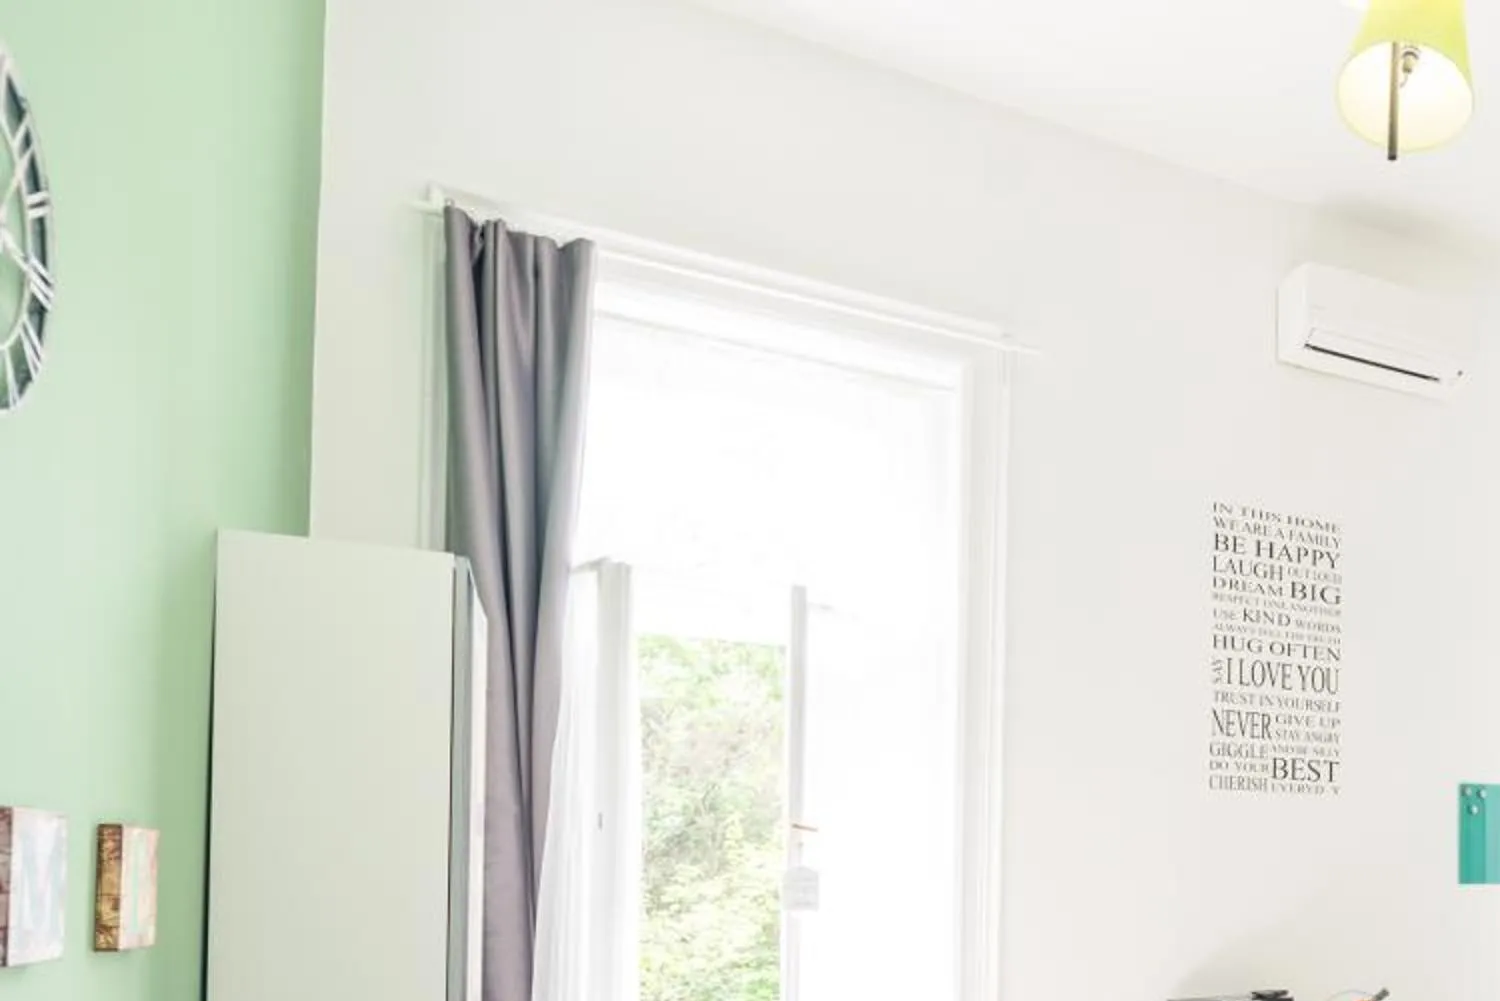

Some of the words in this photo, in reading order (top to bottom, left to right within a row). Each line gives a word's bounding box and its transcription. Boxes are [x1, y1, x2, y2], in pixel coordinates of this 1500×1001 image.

[1213, 502, 1232, 514] IN
[1242, 506, 1281, 522] THIS
[1287, 515, 1340, 533] HOME
[1213, 516, 1237, 530] WE
[1242, 522, 1271, 536] ARE
[1275, 528, 1285, 539] A
[1289, 530, 1341, 549] FAMILY
[1215, 533, 1246, 555] BE
[1255, 539, 1341, 569] HAPPY
[1213, 555, 1283, 581] LAUGH
[1213, 576, 1283, 597] DREAM
[1291, 581, 1341, 605] BIG
[1213, 607, 1238, 621] USE
[1243, 608, 1291, 627] KIND
[1295, 619, 1341, 634] WORDS
[1213, 634, 1263, 654] HUG
[1269, 641, 1340, 661] OFTEN
[1227, 657, 1232, 685] I
[1239, 658, 1292, 691] LOVE
[1298, 664, 1339, 695] YOU
[1214, 690, 1254, 705] TRUST
[1259, 694, 1273, 707] IN
[1277, 696, 1339, 713] YOURSELF
[1212, 707, 1271, 740] NEVER
[1275, 714, 1314, 728] GIVE
[1319, 717, 1340, 729] UP
[1210, 742, 1268, 759] GIGGLE
[1210, 760, 1228, 771] DO
[1234, 761, 1269, 773] YOUR
[1273, 757, 1340, 782] BEST
[1210, 774, 1267, 793] CHERISH
